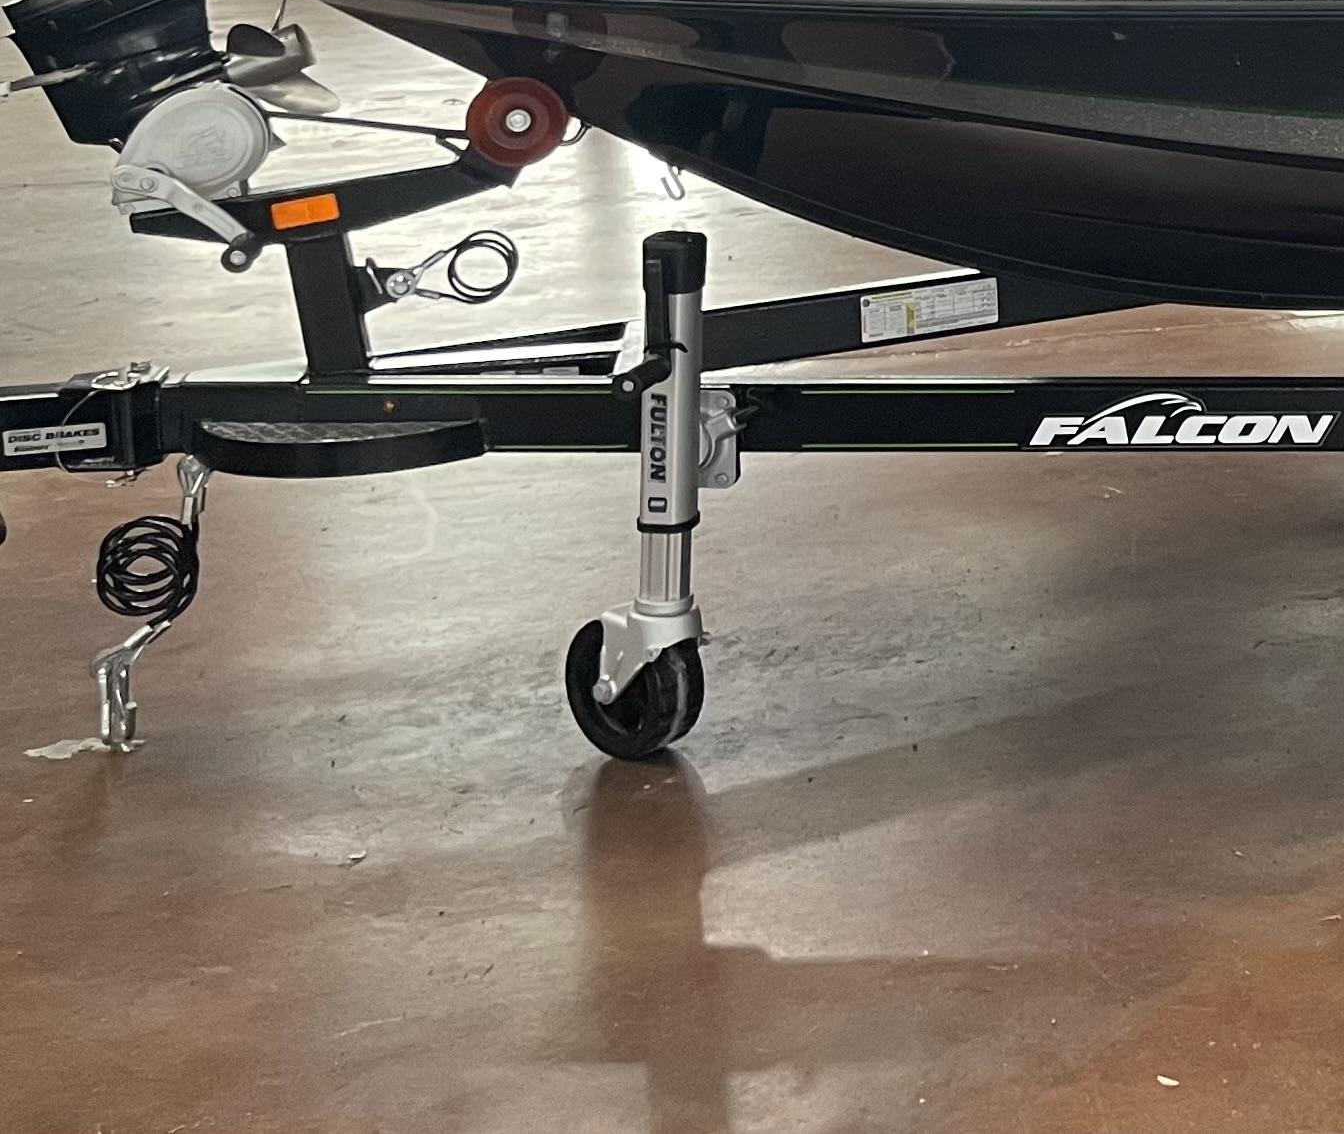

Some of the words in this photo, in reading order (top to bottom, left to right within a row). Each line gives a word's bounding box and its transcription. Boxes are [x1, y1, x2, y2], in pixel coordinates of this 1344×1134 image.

[8, 433, 41, 444] DISC
[45, 427, 100, 440] BRAKES
[650, 393, 667, 483] FULTON
[1027, 413, 1335, 446] FALCON
